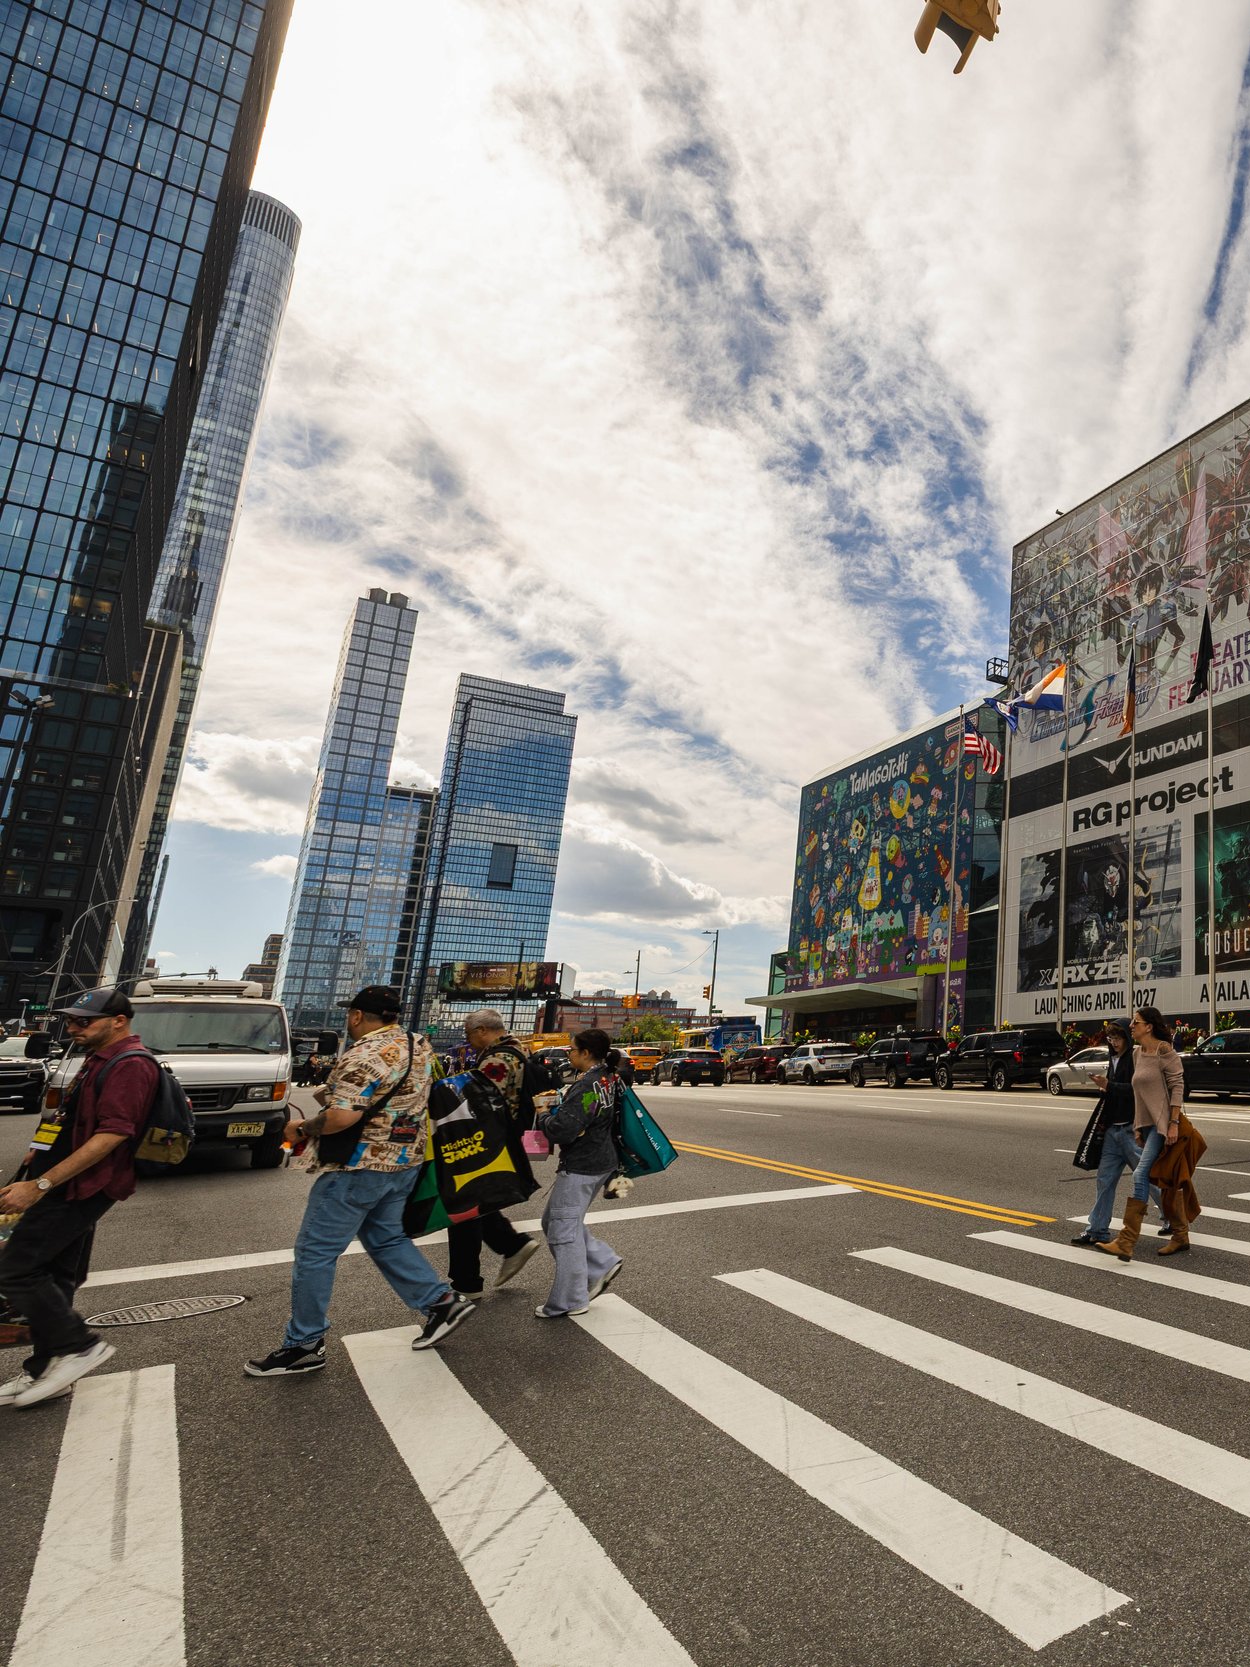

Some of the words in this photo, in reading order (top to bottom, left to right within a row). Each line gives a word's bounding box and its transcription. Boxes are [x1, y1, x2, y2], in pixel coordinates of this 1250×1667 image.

[1127, 731, 1203, 769] GUNDAM
[1073, 801, 1112, 832] RG
[1116, 766, 1234, 828] project
[1095, 991, 1126, 1010] APRIL
[441, 1137, 474, 1153] Mighty
